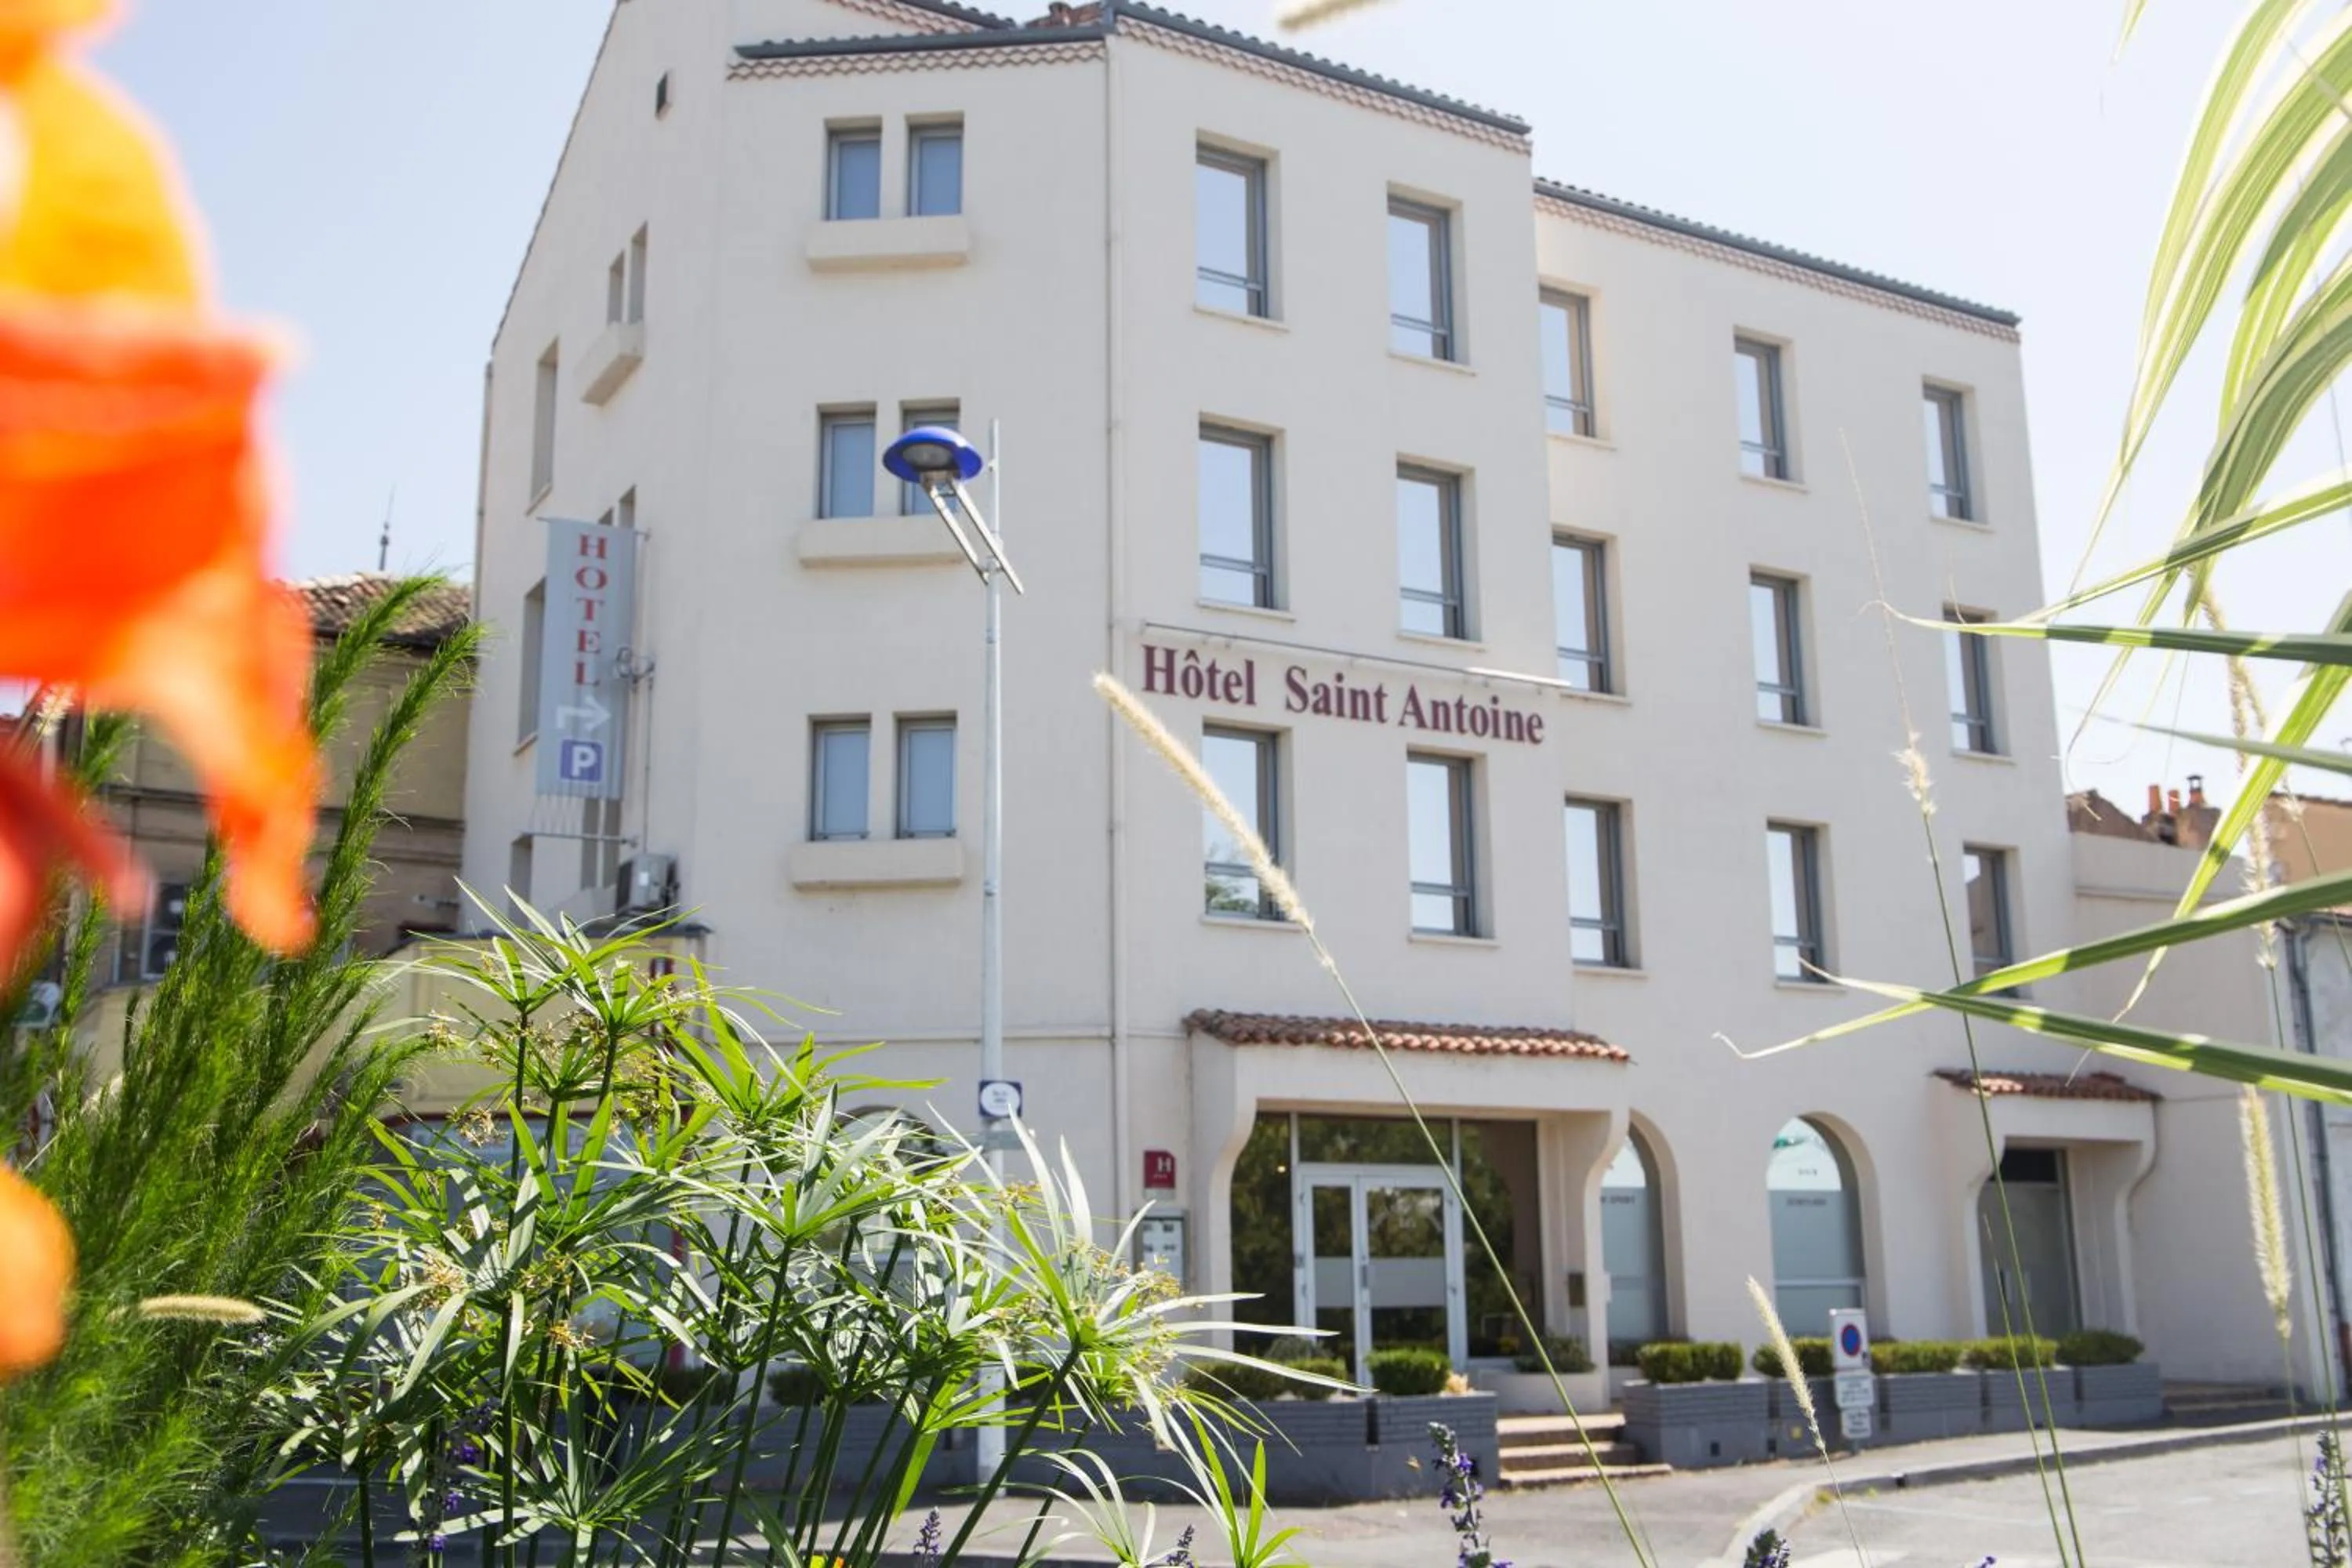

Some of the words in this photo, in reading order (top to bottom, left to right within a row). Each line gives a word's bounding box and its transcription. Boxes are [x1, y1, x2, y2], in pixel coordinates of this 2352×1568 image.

[575, 535, 608, 686] HOTEL
[1142, 645, 1256, 706] Hôtel
[1286, 666, 1388, 724] Saint
[1399, 684, 1544, 744] Antoine
[572, 746, 597, 778] P
